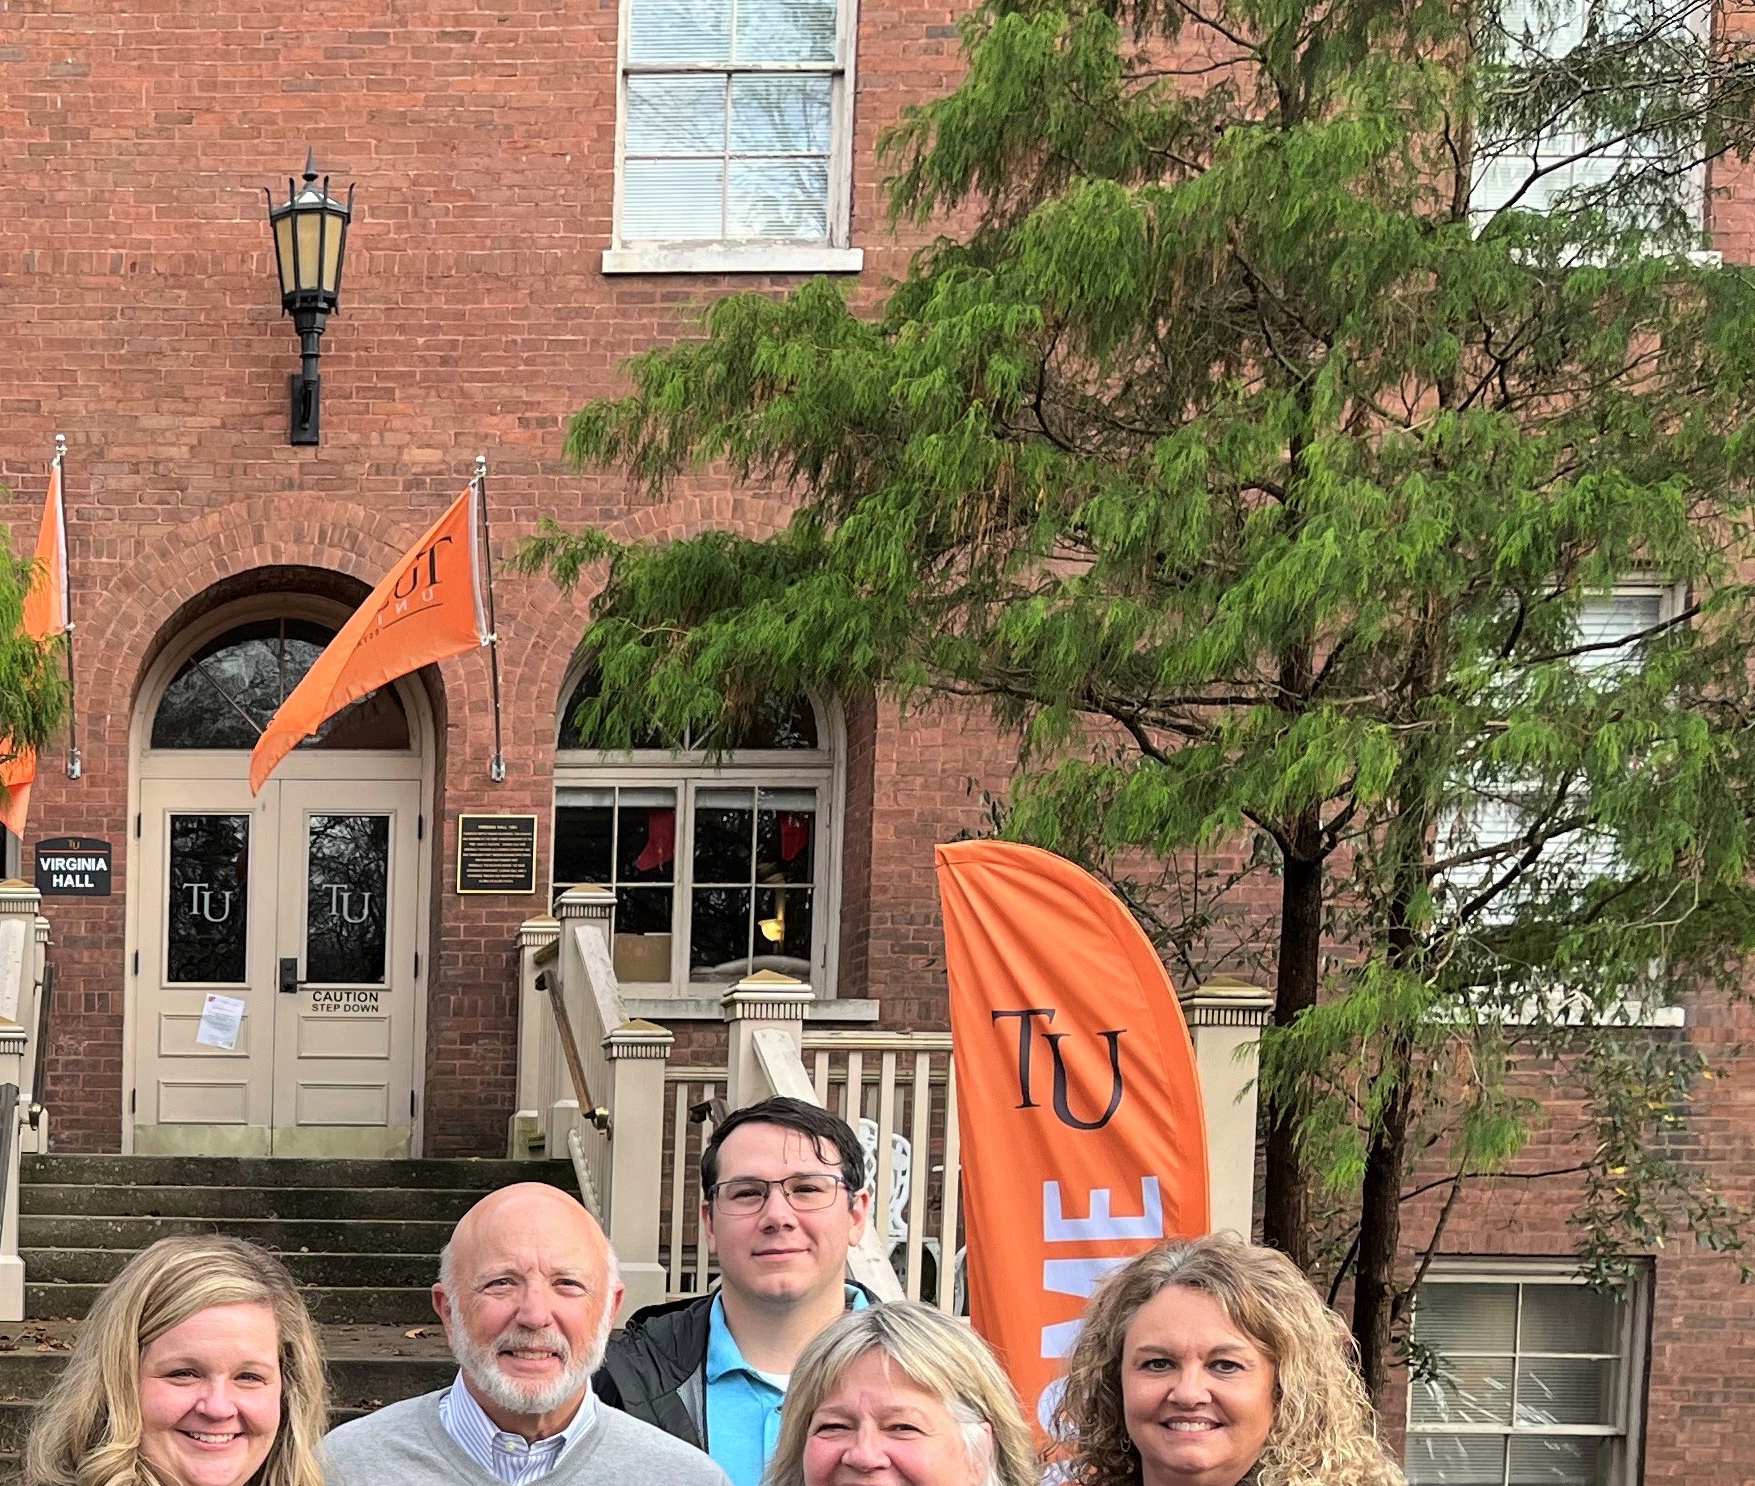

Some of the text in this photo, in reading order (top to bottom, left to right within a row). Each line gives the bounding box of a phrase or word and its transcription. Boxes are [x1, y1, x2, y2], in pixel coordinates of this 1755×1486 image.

[68, 839, 81, 850] TU
[39, 857, 108, 872] VIRGINIA
[52, 873, 95, 888] HALL
[182, 882, 234, 923] TU
[321, 883, 372, 924] TU
[312, 991, 379, 1003] CAUTION
[312, 1003, 379, 1013] STEP DOWN
[991, 1008, 1127, 1131] TU
